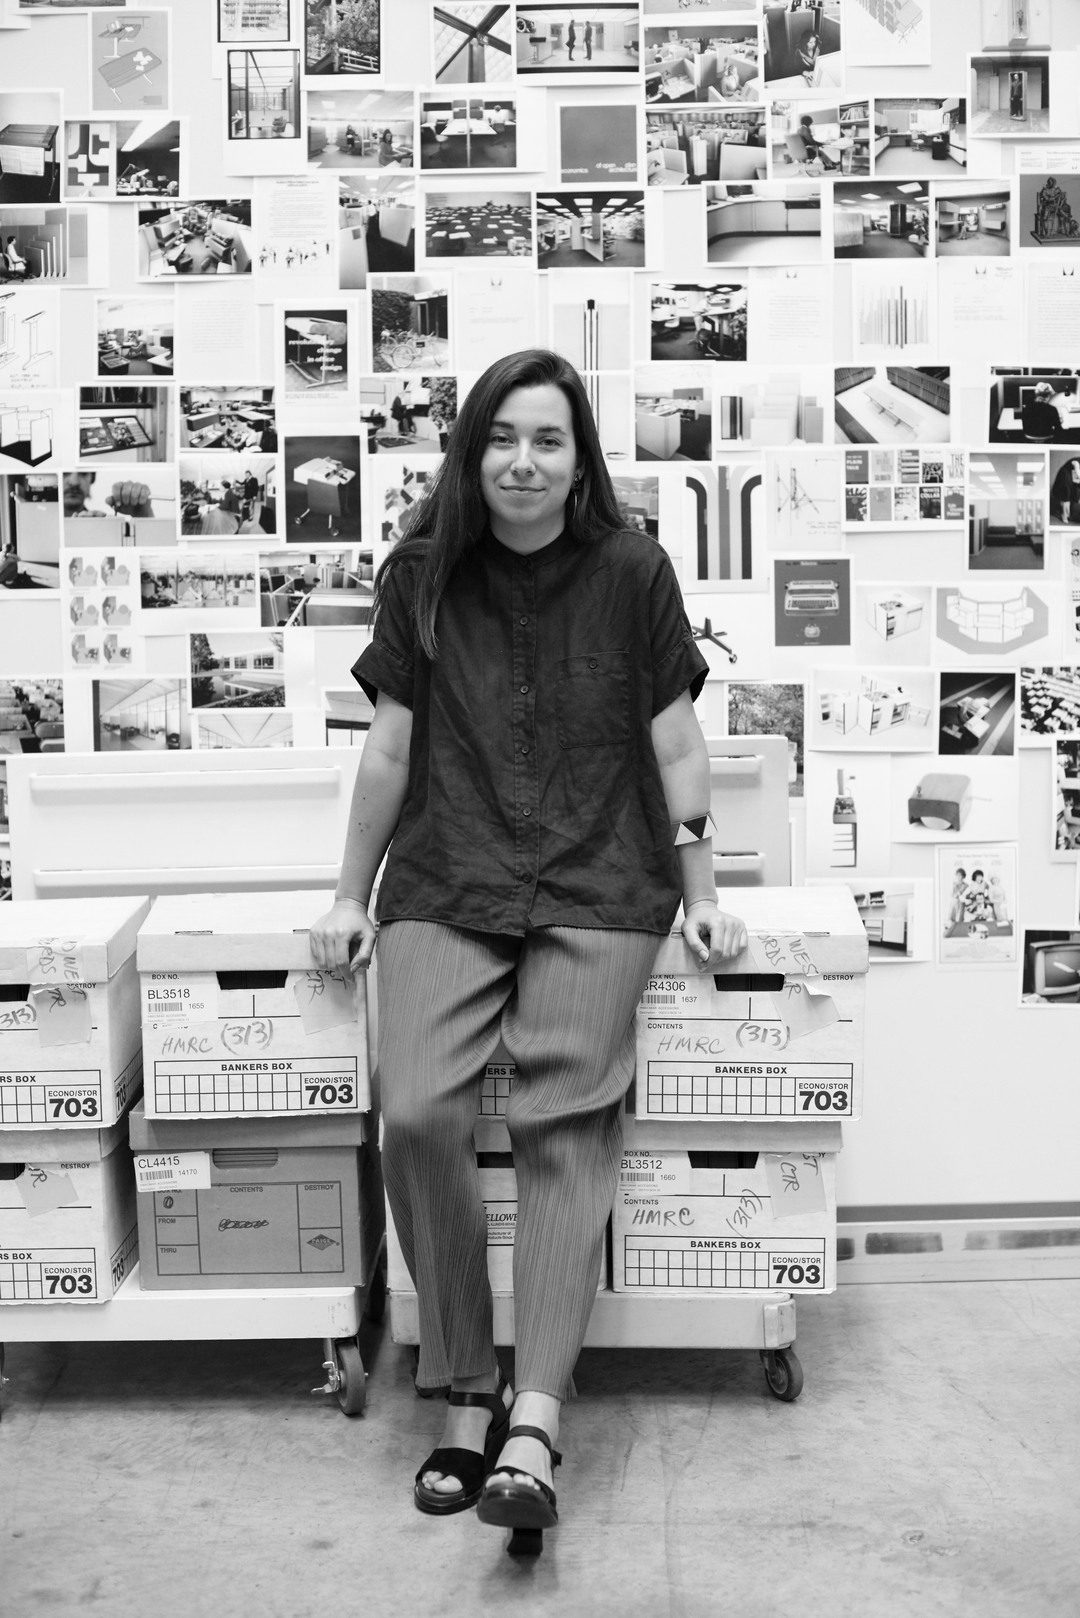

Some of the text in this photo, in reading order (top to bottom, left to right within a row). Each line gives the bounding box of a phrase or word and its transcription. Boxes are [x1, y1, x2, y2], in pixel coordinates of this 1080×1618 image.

[147, 988, 191, 1000] BL3518
[188, 1002, 205, 1010] 1655
[161, 1035, 214, 1056] HMRC
[657, 1035, 726, 1055] HMRC
[221, 1062, 293, 1071] BANKERS BOX
[715, 1066, 788, 1075] BANKERS BOX
[15, 1075, 37, 1083] BOX
[304, 1076, 354, 1085] ECONO/STOR
[798, 1082, 849, 1090] ECONO/STOR
[48, 1089, 98, 1097] ECONO/STOR
[304, 1084, 354, 1105] 703
[799, 1090, 849, 1111] 703
[49, 1097, 98, 1118] 703
[138, 1155, 180, 1169] CL4415
[620, 1159, 663, 1170] BL3512
[178, 1168, 198, 1177] 14170
[624, 1198, 659, 1206] CONTENTS
[632, 1207, 696, 1227] HMRC
[690, 1240, 762, 1249] BANKERS BOX
[12, 1252, 33, 1260] BOX
[772, 1264, 821, 1284] 703
[45, 1274, 93, 1295] 703
